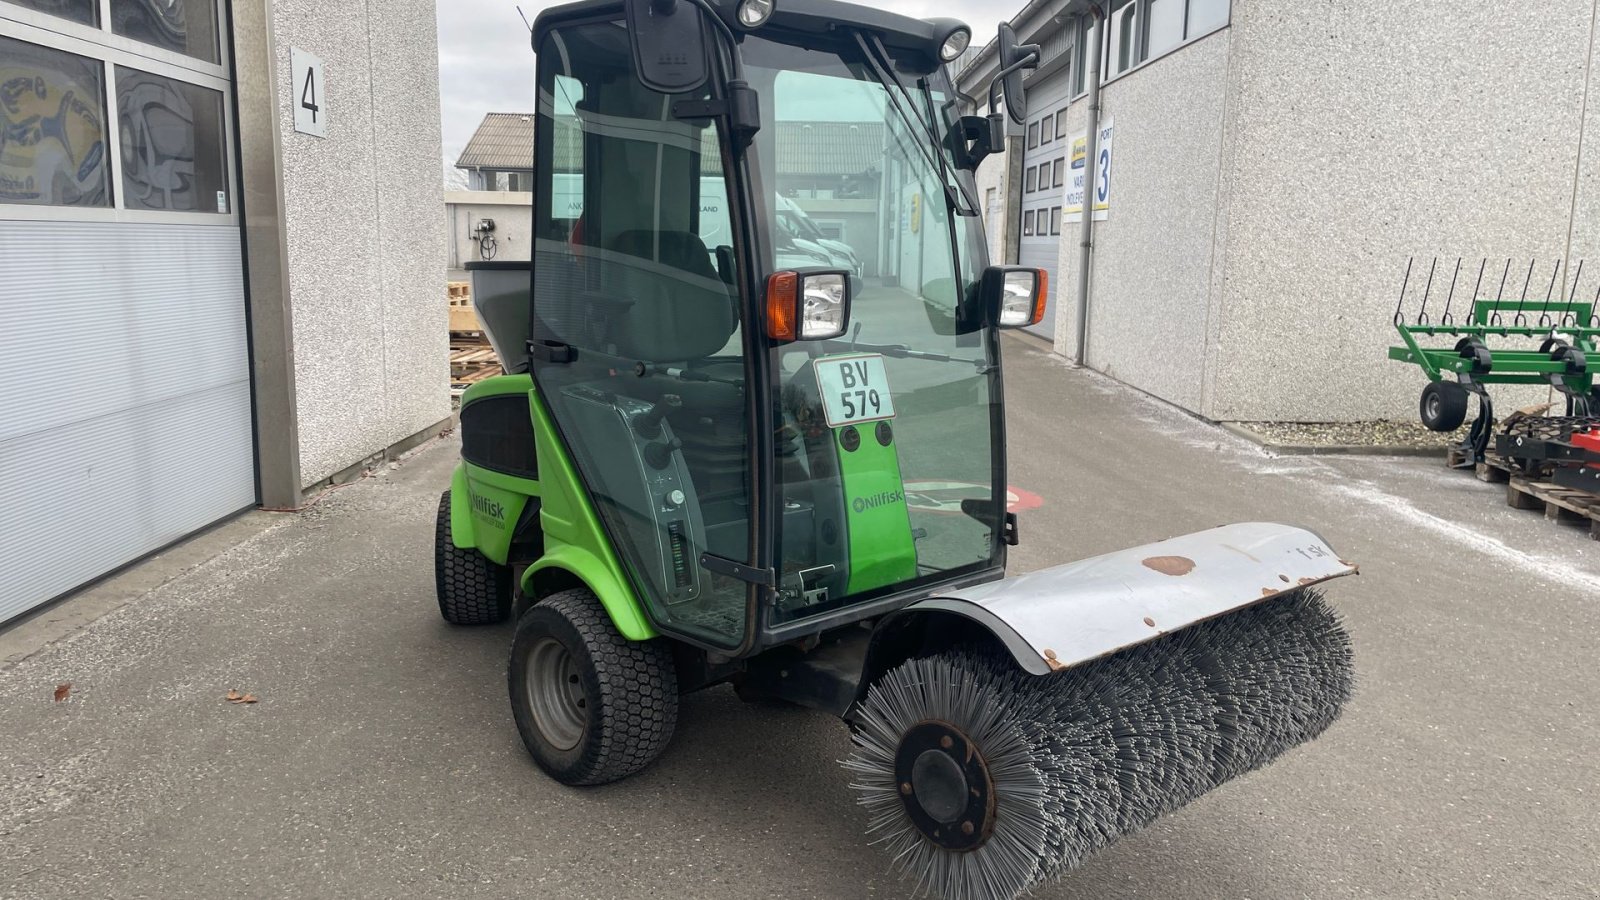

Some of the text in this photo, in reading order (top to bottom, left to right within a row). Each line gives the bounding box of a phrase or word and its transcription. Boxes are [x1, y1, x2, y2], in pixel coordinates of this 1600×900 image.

[302, 66, 318, 123] 4
[1101, 127, 1112, 141] PORT
[1098, 149, 1109, 202] 3
[839, 361, 869, 389] BV
[841, 389, 881, 419] 579
[472, 494, 505, 520] Nilfisk
[865, 490, 903, 509] Nilfisk
